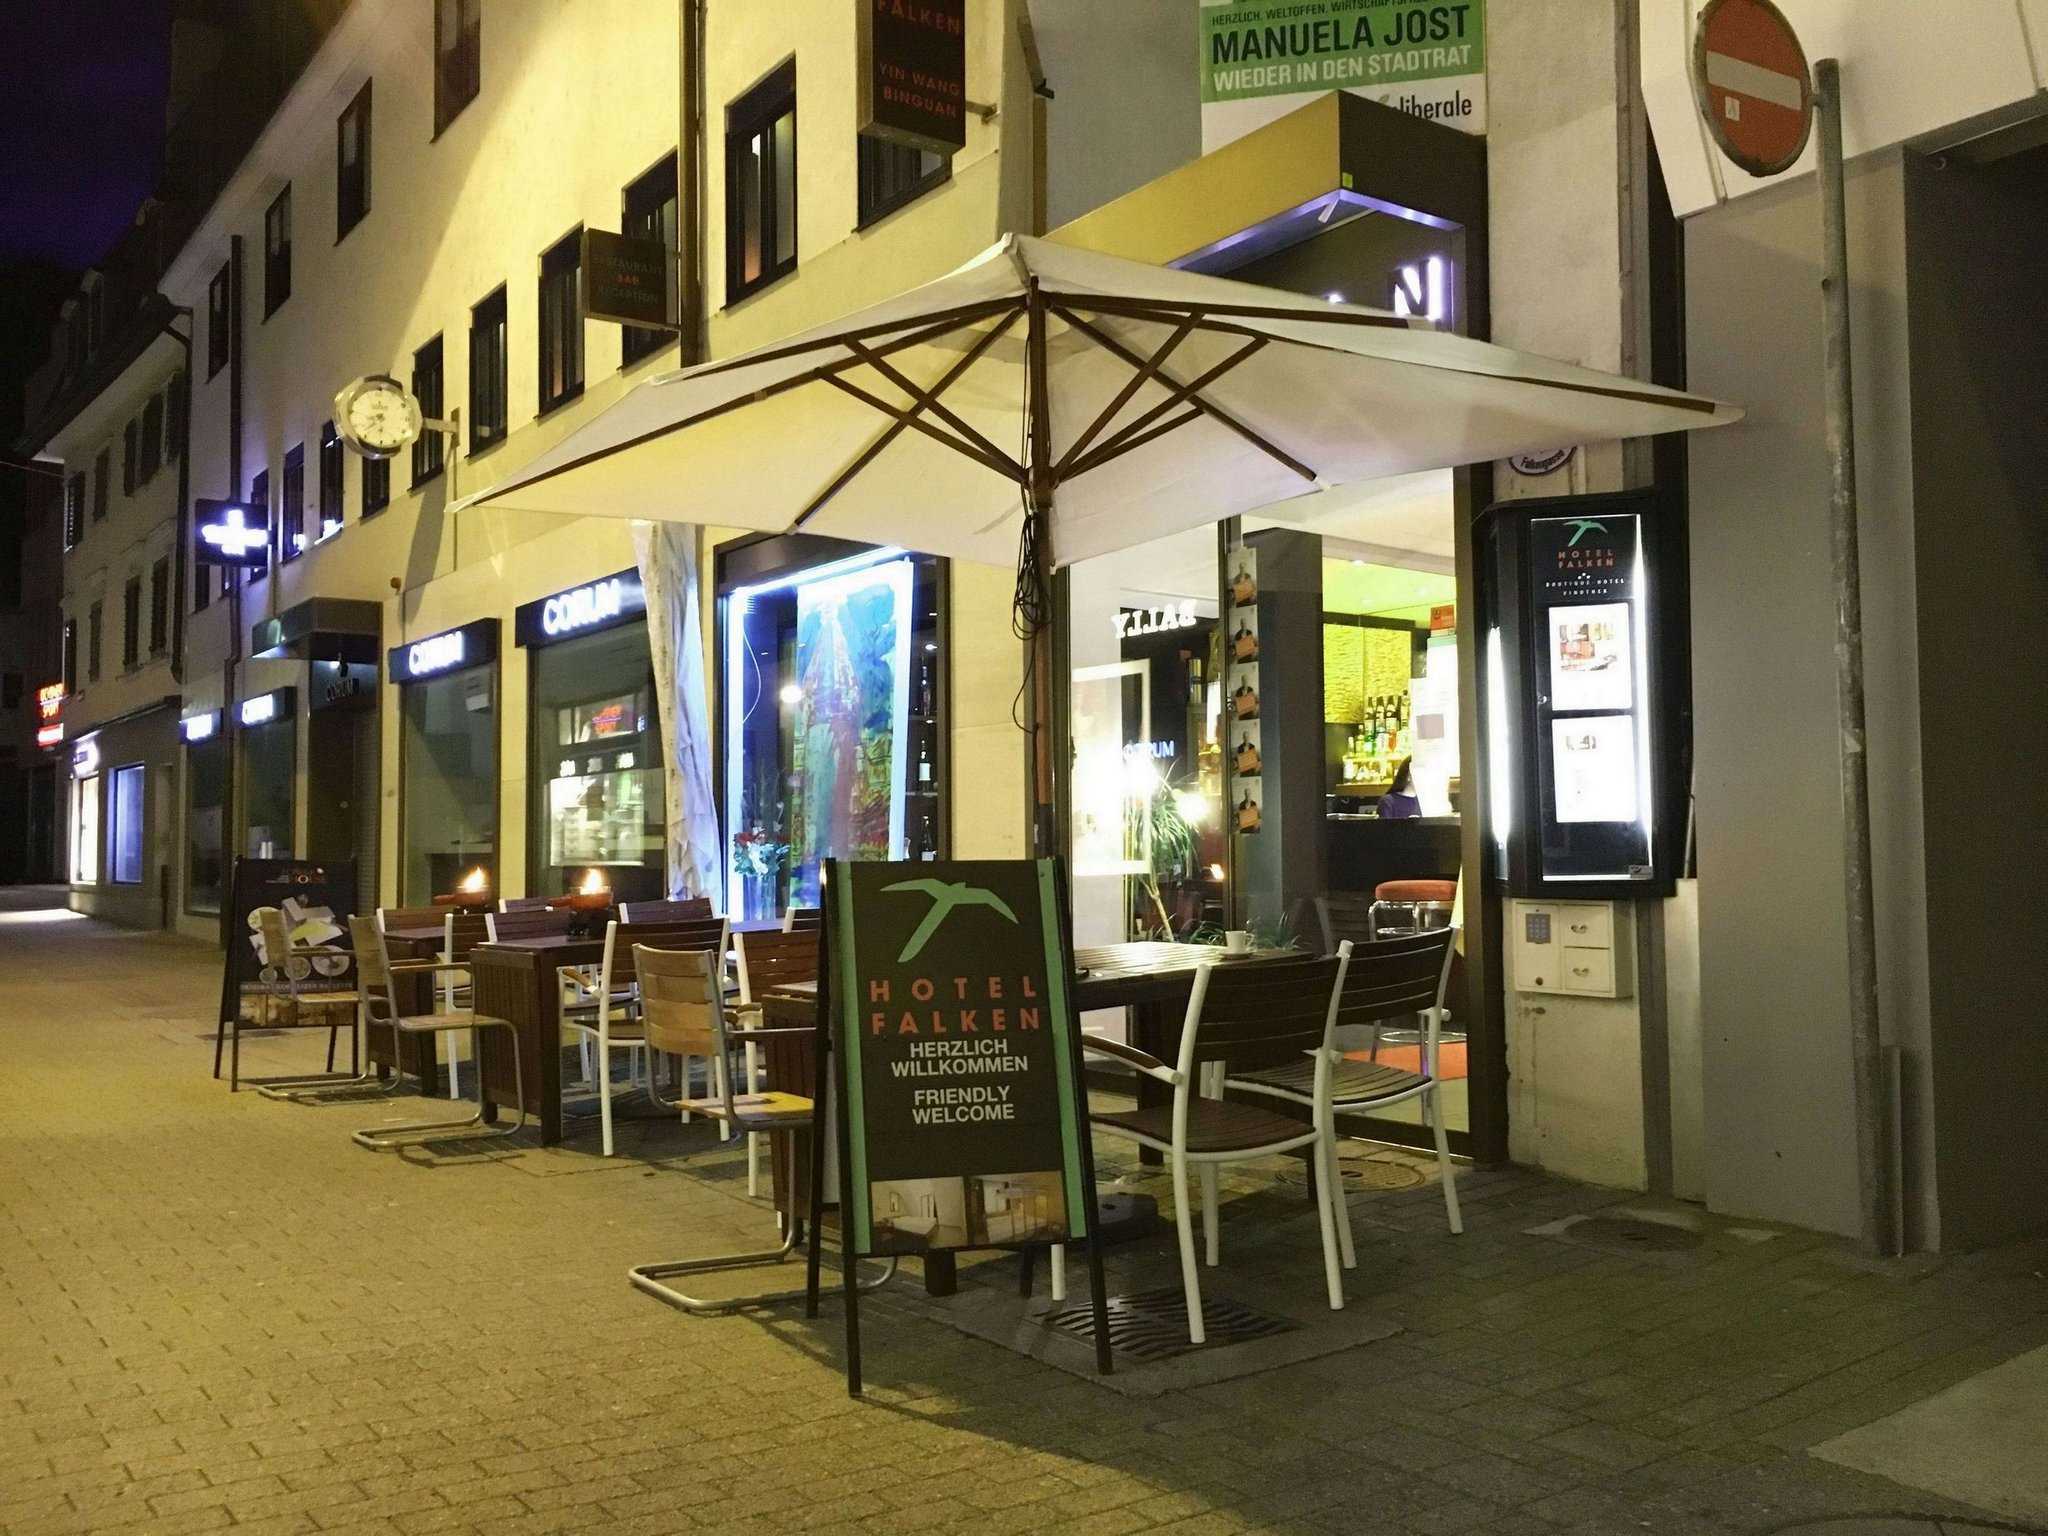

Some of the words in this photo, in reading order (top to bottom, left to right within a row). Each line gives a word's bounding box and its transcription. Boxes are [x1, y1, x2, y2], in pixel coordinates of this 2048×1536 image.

[878, 0, 960, 36] FALKEN
[1212, 16, 1374, 64] MANUELA
[1384, 5, 1470, 46] JOST
[879, 62, 905, 80] YIN
[912, 72, 960, 97] WANG
[1213, 64, 1291, 92] WIEDER
[1297, 62, 1317, 83] IN
[1323, 57, 1362, 80] DEN
[1368, 45, 1471, 76] STADTRAT
[1394, 89, 1473, 120] liberale
[1558, 549, 1613, 559] HOTEL
[1558, 558, 1614, 569] FALKEN
[869, 976, 1037, 1003] HOTEL
[871, 1007, 1040, 1035] FALKEN
[909, 1039, 1008, 1058] HERZLICH
[891, 1056, 1029, 1078] WILLKOMMEN
[913, 1085, 1011, 1106] FRIENDLY
[912, 1103, 1015, 1124] WELCOME
